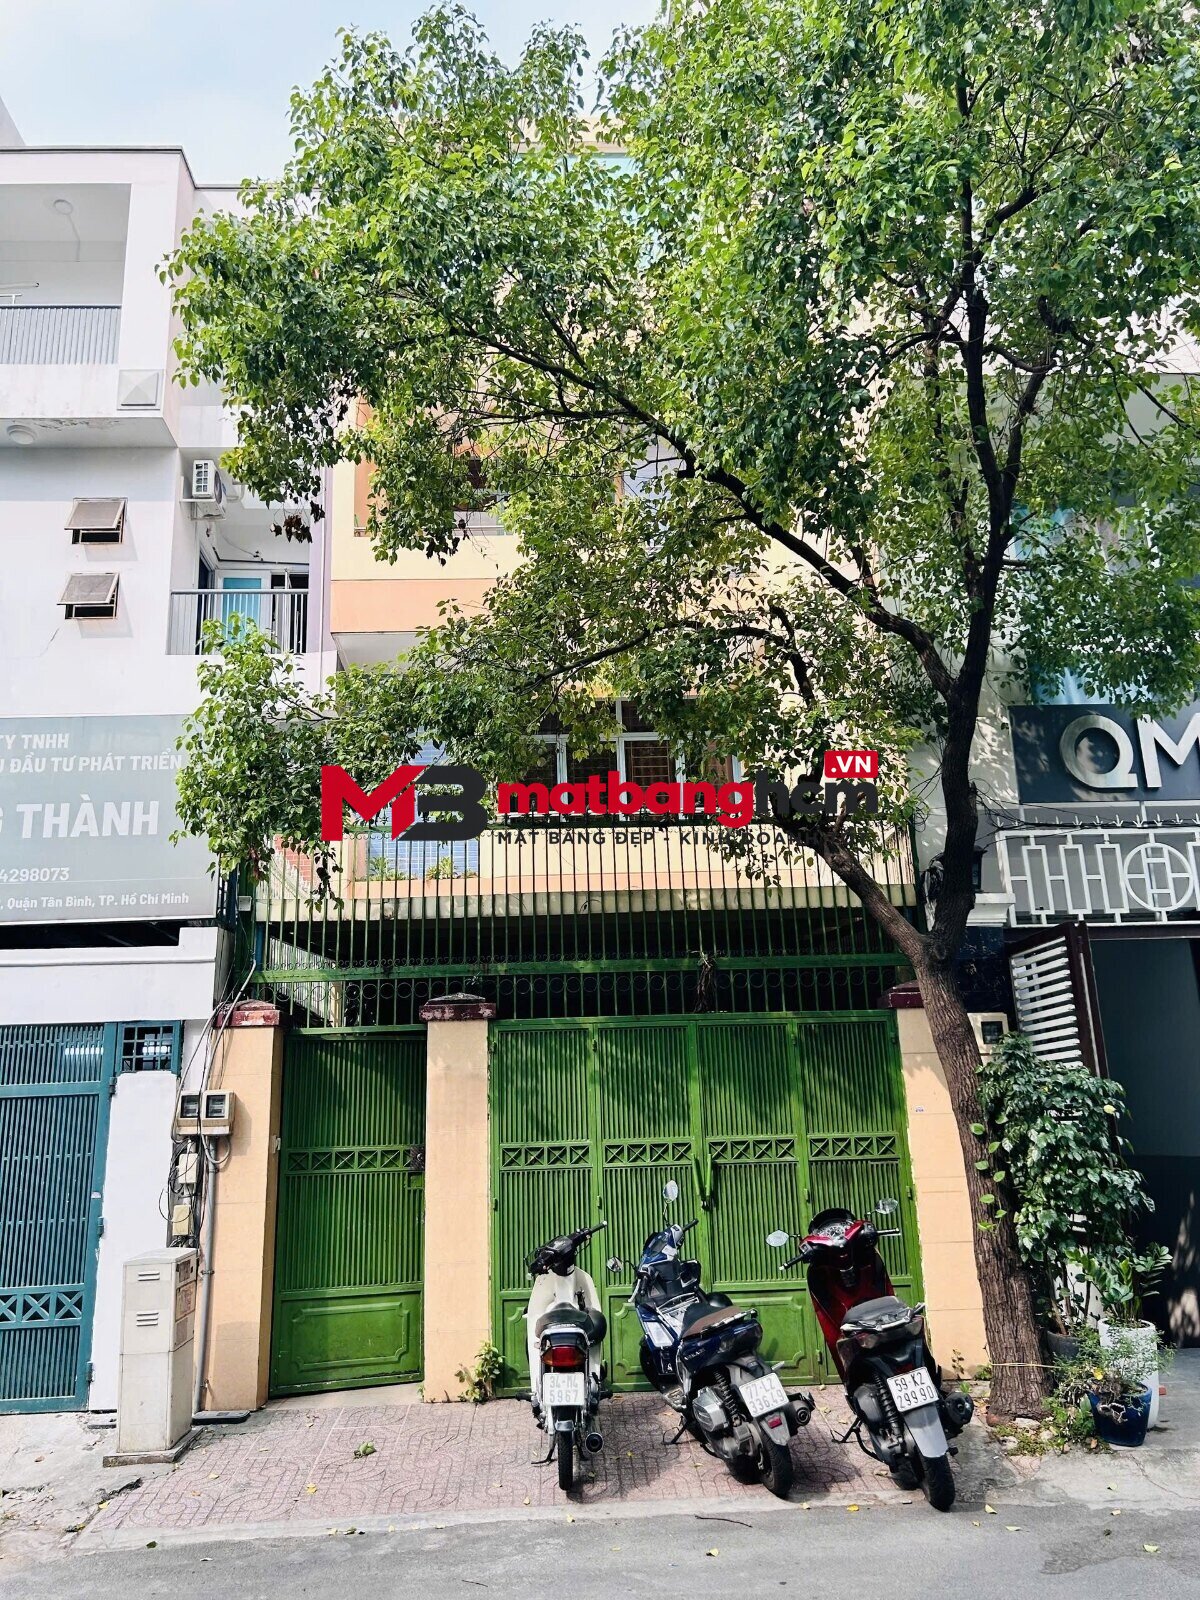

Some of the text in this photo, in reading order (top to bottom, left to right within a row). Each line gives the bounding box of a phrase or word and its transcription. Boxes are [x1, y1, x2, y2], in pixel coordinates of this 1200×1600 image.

[21, 733, 70, 750] TNHH
[9, 751, 47, 773] ĐẦU
[50, 755, 77, 773] TƯ
[78, 752, 126, 772] PHÁT
[130, 748, 182, 771] TRIỂN
[16, 794, 160, 839] THÀNH
[0, 867, 70, 882] 4298073
[7, 897, 38, 912] Quận
[41, 896, 63, 908] Tân
[99, 895, 118, 907] TP.
[121, 893, 137, 906] Hồ
[140, 893, 158, 906] Chí
[161, 892, 189, 905] Minh
[549, 1390, 578, 1403] 5967
